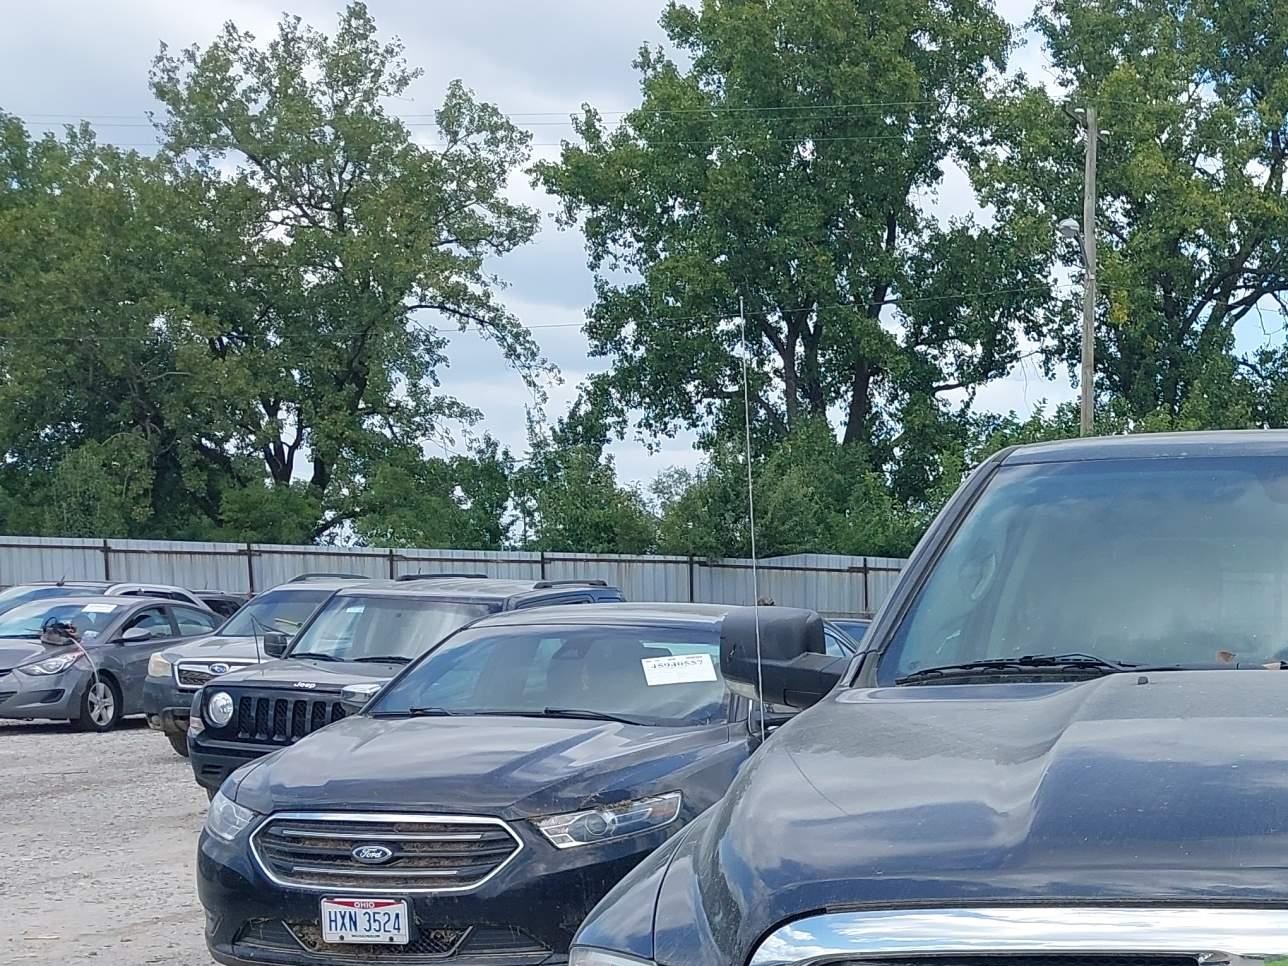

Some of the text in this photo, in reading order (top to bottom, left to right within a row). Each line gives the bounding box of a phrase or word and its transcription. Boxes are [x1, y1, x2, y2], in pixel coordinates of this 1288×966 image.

[293, 681, 316, 689] Jeep
[360, 848, 383, 859] Ford
[354, 901, 375, 909] OHIO
[328, 910, 401, 933] HXN 3524
